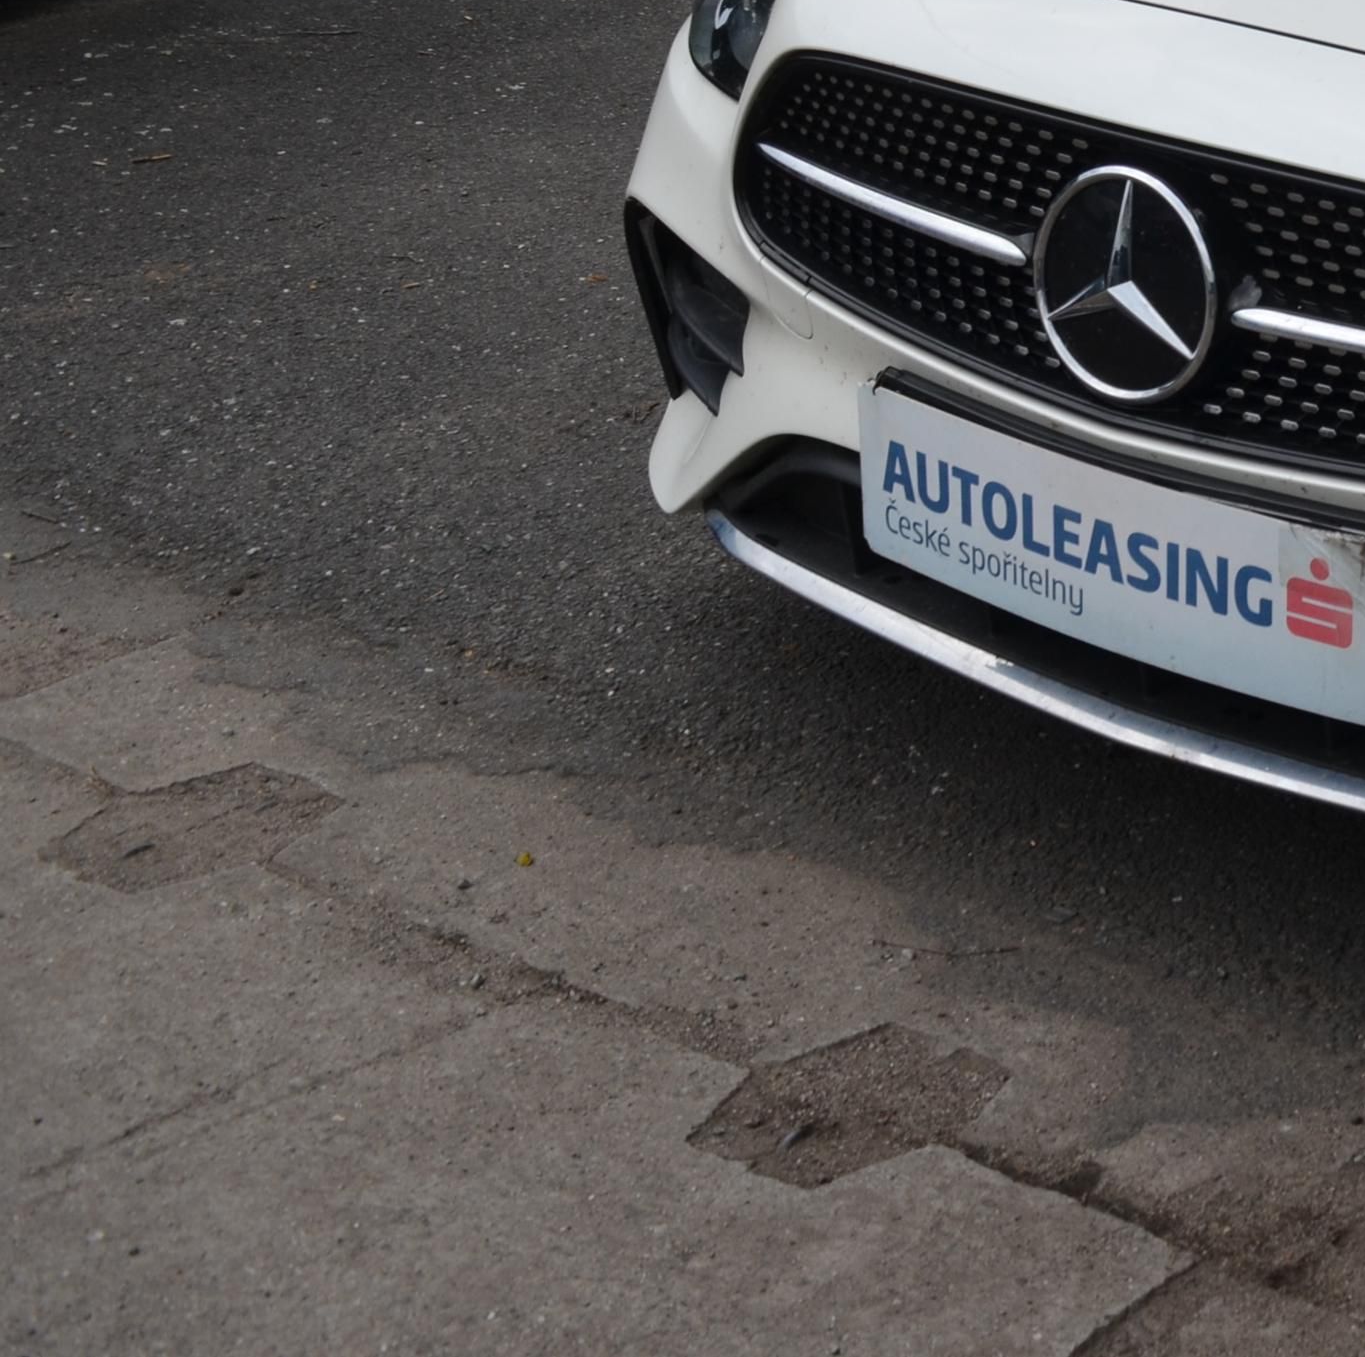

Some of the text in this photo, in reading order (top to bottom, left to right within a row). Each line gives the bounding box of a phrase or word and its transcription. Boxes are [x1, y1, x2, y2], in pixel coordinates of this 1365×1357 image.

[882, 440, 1274, 628] AUTOLEASING
[884, 496, 1085, 617] České spořitelny
